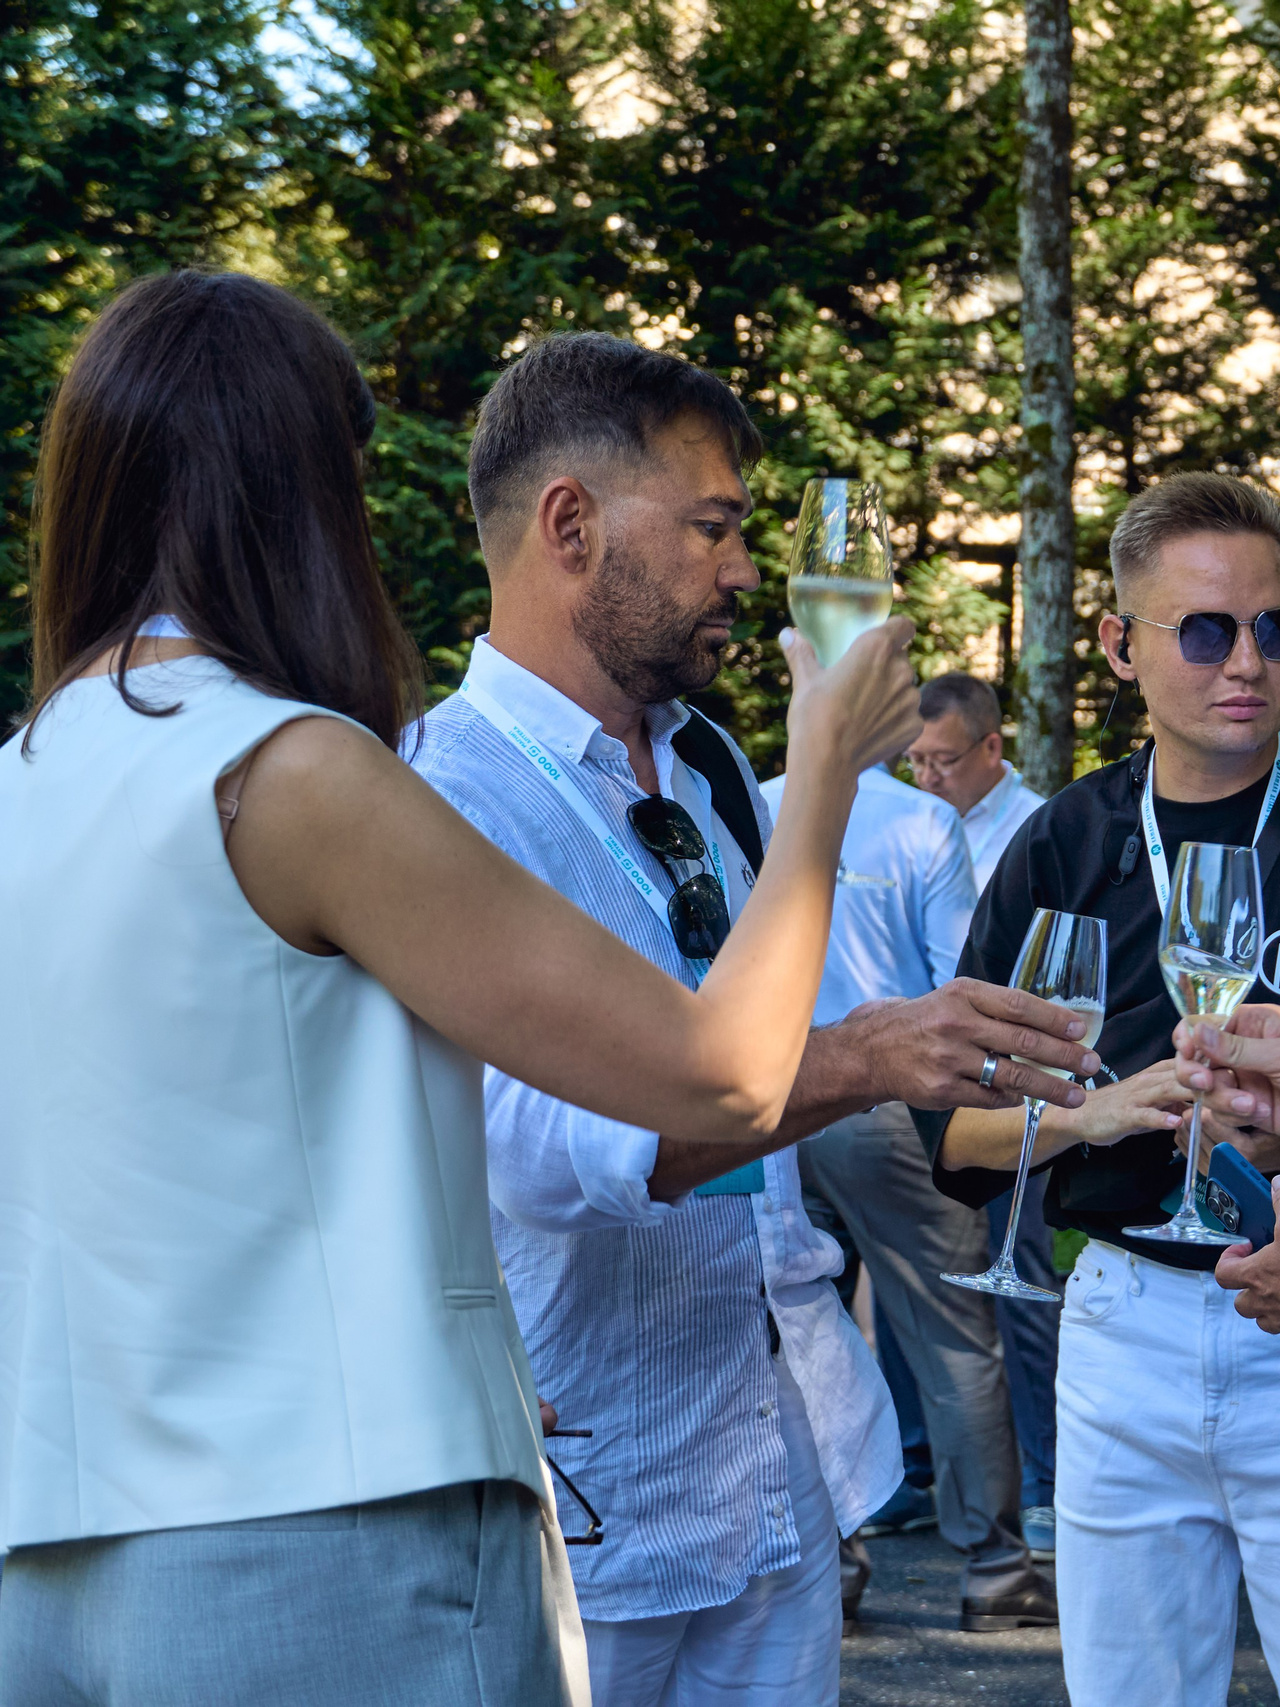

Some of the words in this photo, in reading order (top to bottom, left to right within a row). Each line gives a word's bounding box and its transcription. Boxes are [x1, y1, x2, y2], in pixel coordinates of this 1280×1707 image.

[508, 730, 527, 748] МАГНИТ
[513, 726, 532, 744] АПТЕКА
[537, 756, 561, 781] 1000
[604, 838, 621, 860] МАГНИТ
[608, 835, 625, 855] АПТЕКА
[631, 870, 652, 895] 1000
